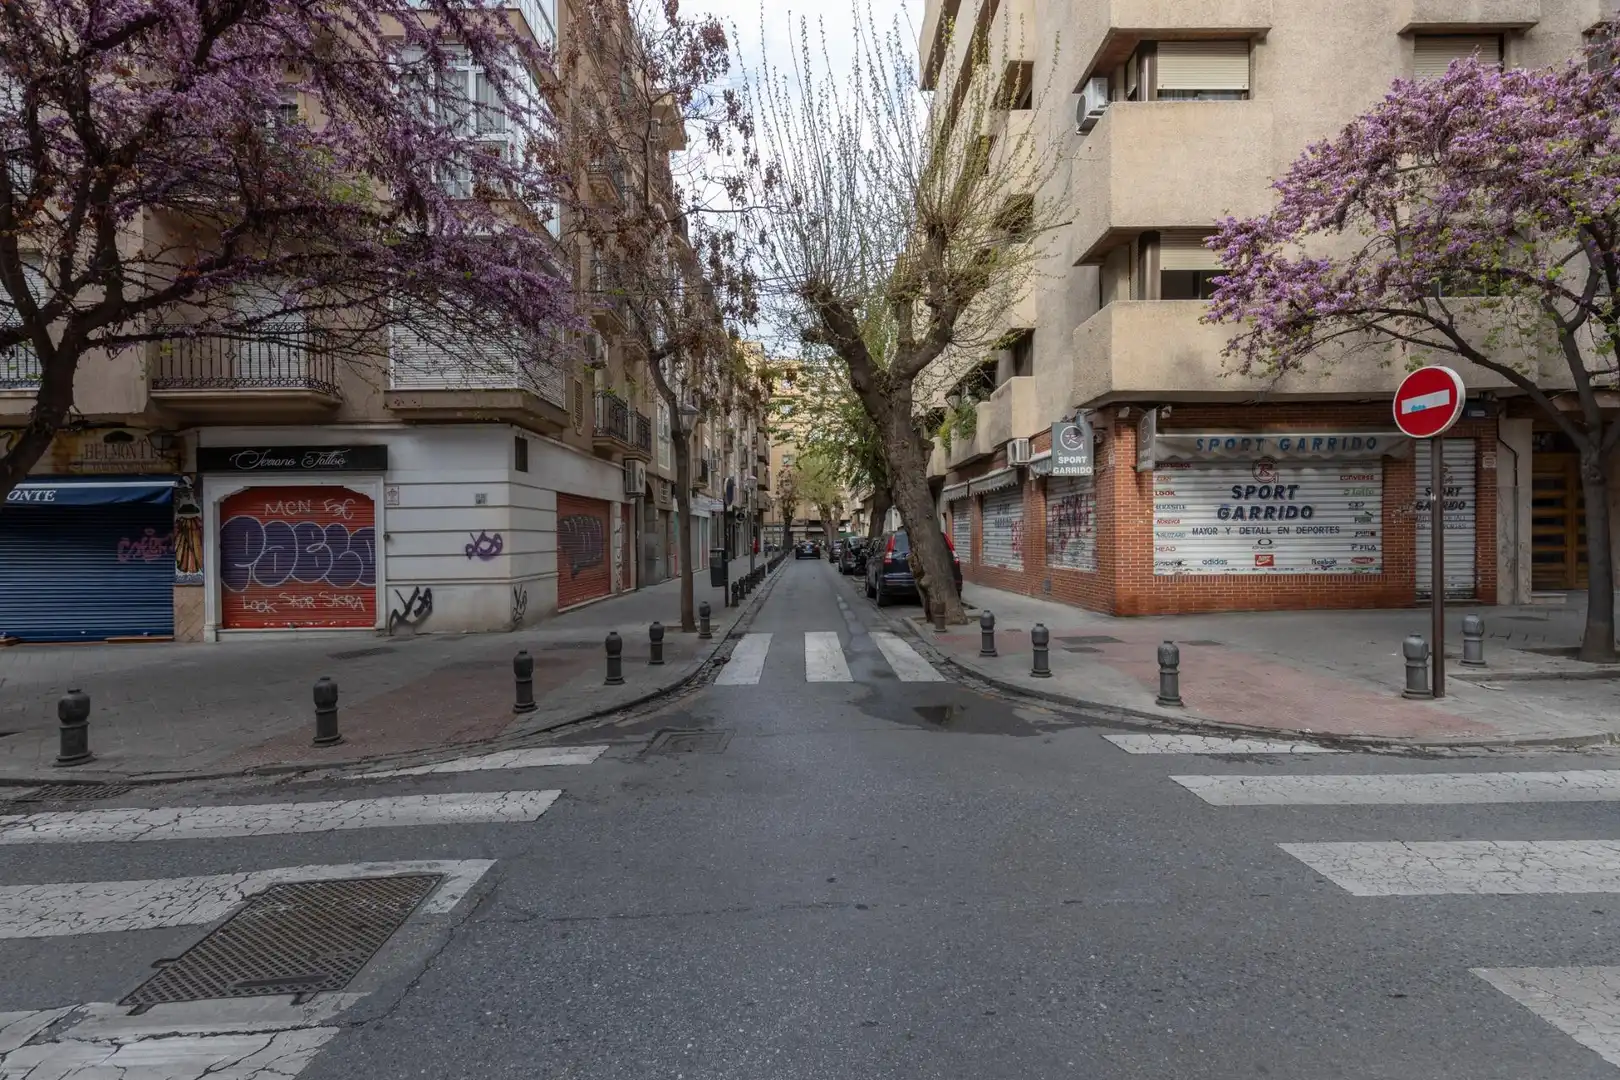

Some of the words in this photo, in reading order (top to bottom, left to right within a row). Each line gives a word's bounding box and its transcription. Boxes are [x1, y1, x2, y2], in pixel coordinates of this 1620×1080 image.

[1196, 438, 1266, 452] SPORT
[1279, 437, 1376, 451] GARRIDO
[230, 449, 296, 470] Serrano
[301, 449, 351, 468] Tattoo
[1058, 456, 1088, 464] SPORT
[7, 490, 56, 501] ONTE
[1232, 485, 1300, 500] SPORT
[1217, 505, 1314, 520] GARRIDO
[1192, 527, 1218, 535] MAYOR
[1225, 527, 1231, 535] Y
[1296, 526, 1340, 534] DEPORTES
